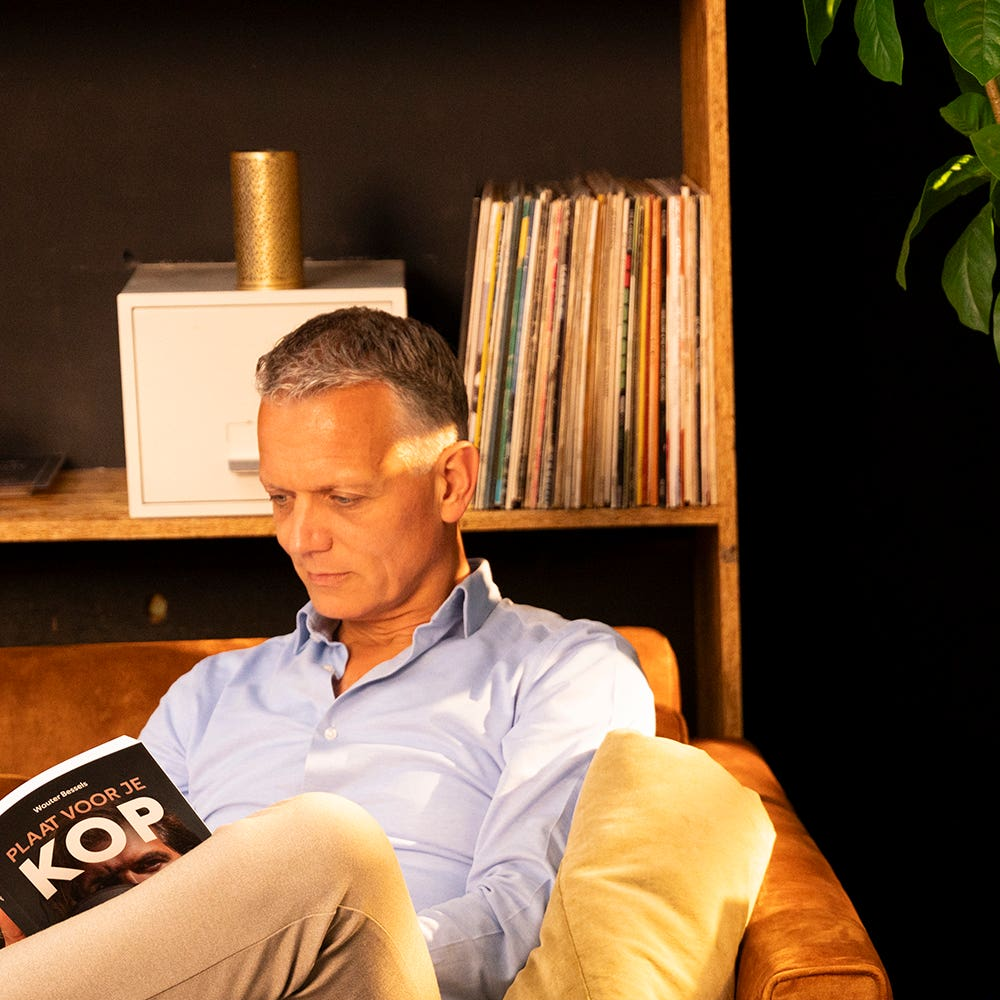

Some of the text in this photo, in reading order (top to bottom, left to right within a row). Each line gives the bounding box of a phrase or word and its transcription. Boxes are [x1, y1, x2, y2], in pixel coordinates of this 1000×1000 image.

[5, 776, 147, 863] PLAAT VOOR JE
[32, 781, 89, 813] Wouter Bessels
[18, 796, 165, 901] KOP
